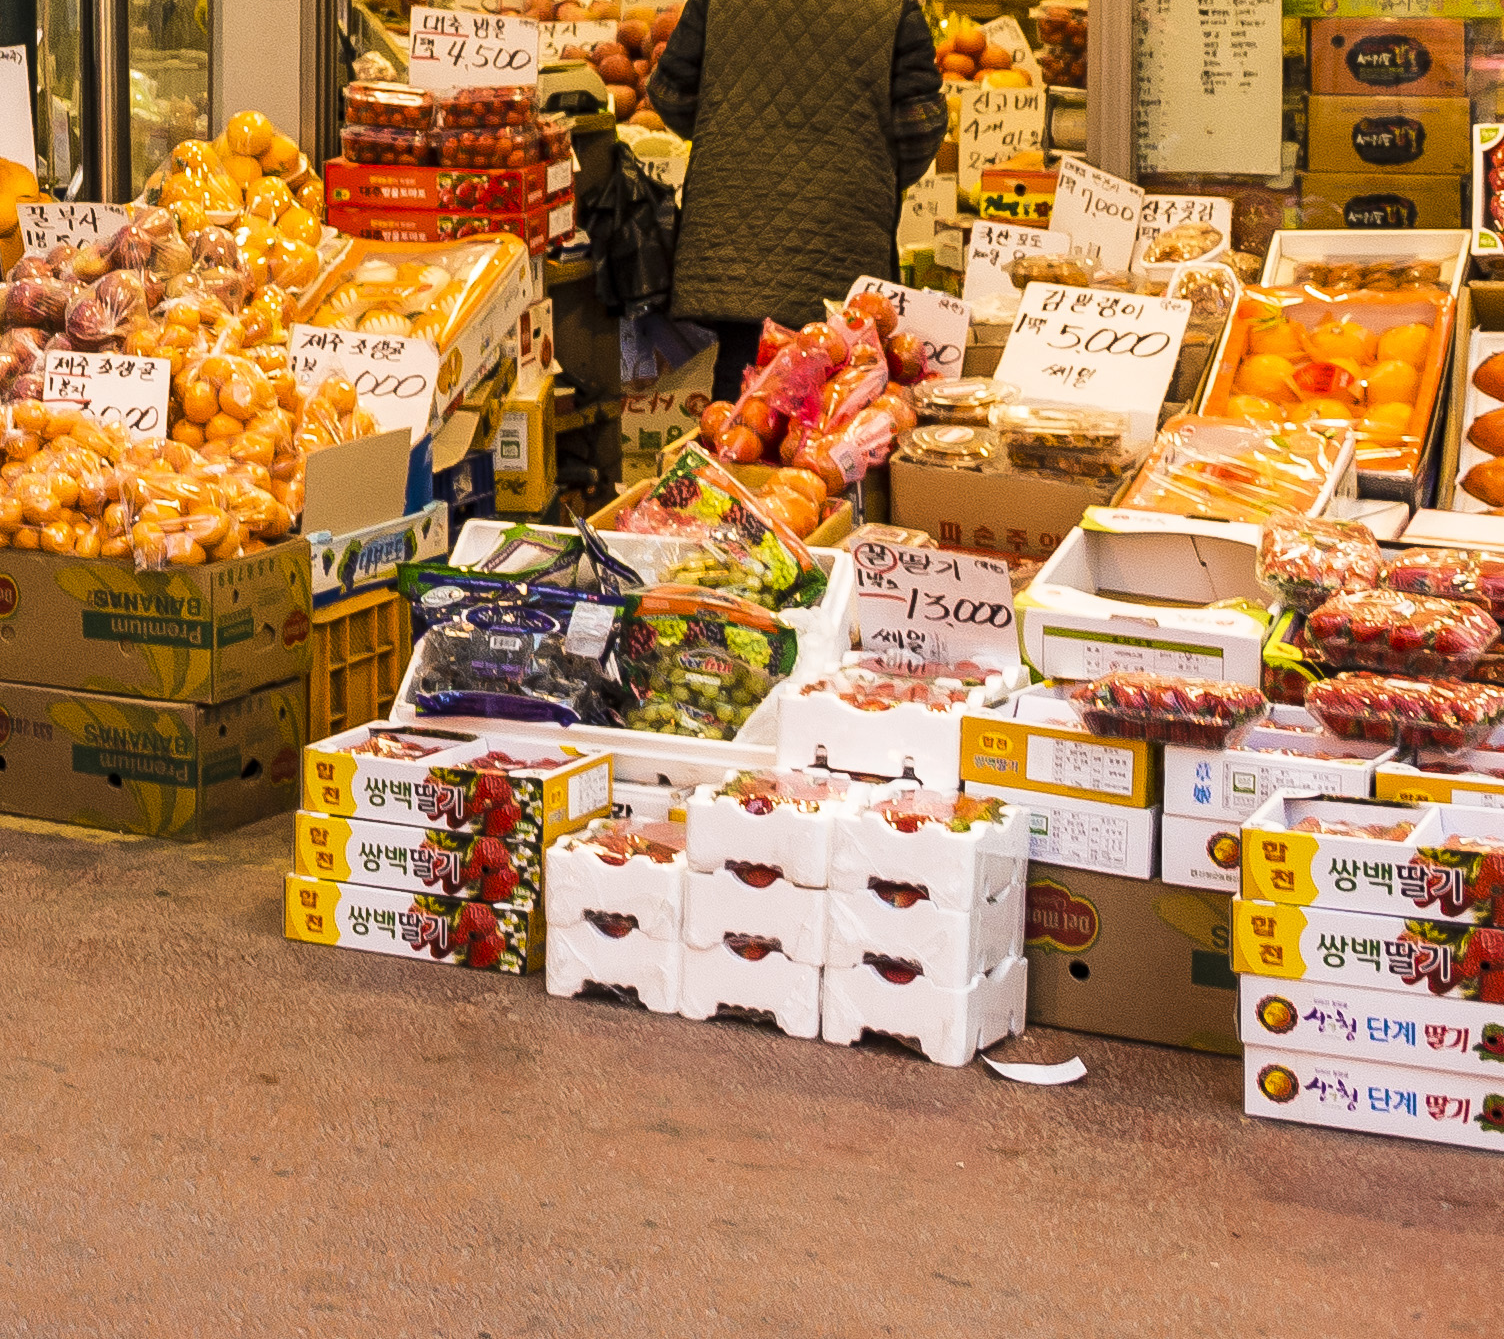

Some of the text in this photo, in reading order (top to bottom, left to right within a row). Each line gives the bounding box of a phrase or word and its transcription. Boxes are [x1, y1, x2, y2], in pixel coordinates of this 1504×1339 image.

[423, 15, 506, 41] 대추 방울
[447, 40, 532, 72] 4,500
[1080, 186, 1134, 221] 7,000
[300, 331, 345, 353] 제주
[1046, 323, 1171, 358] 5,000
[52, 354, 90, 375] 제주
[897, 551, 962, 582] 딸기
[93, 588, 202, 615] BANANAS
[906, 586, 1013, 629] 13,000
[111, 616, 202, 645] Premium
[85, 722, 191, 751] BANANAS
[100, 752, 190, 784] Premium
[363, 774, 464, 817] 쌍백딸기
[357, 839, 462, 885] 쌍백딸기
[1261, 839, 1466, 907] 합천 쌍백딸기
[347, 904, 449, 949] 쌍백딸기
[1250, 915, 1454, 984] 합천 쌍백딸기
[1366, 1016, 1417, 1047] 단계
[1423, 1023, 1470, 1054] 딸기
[1367, 1085, 1418, 1118] 단계
[1424, 1093, 1471, 1125] 딸기
